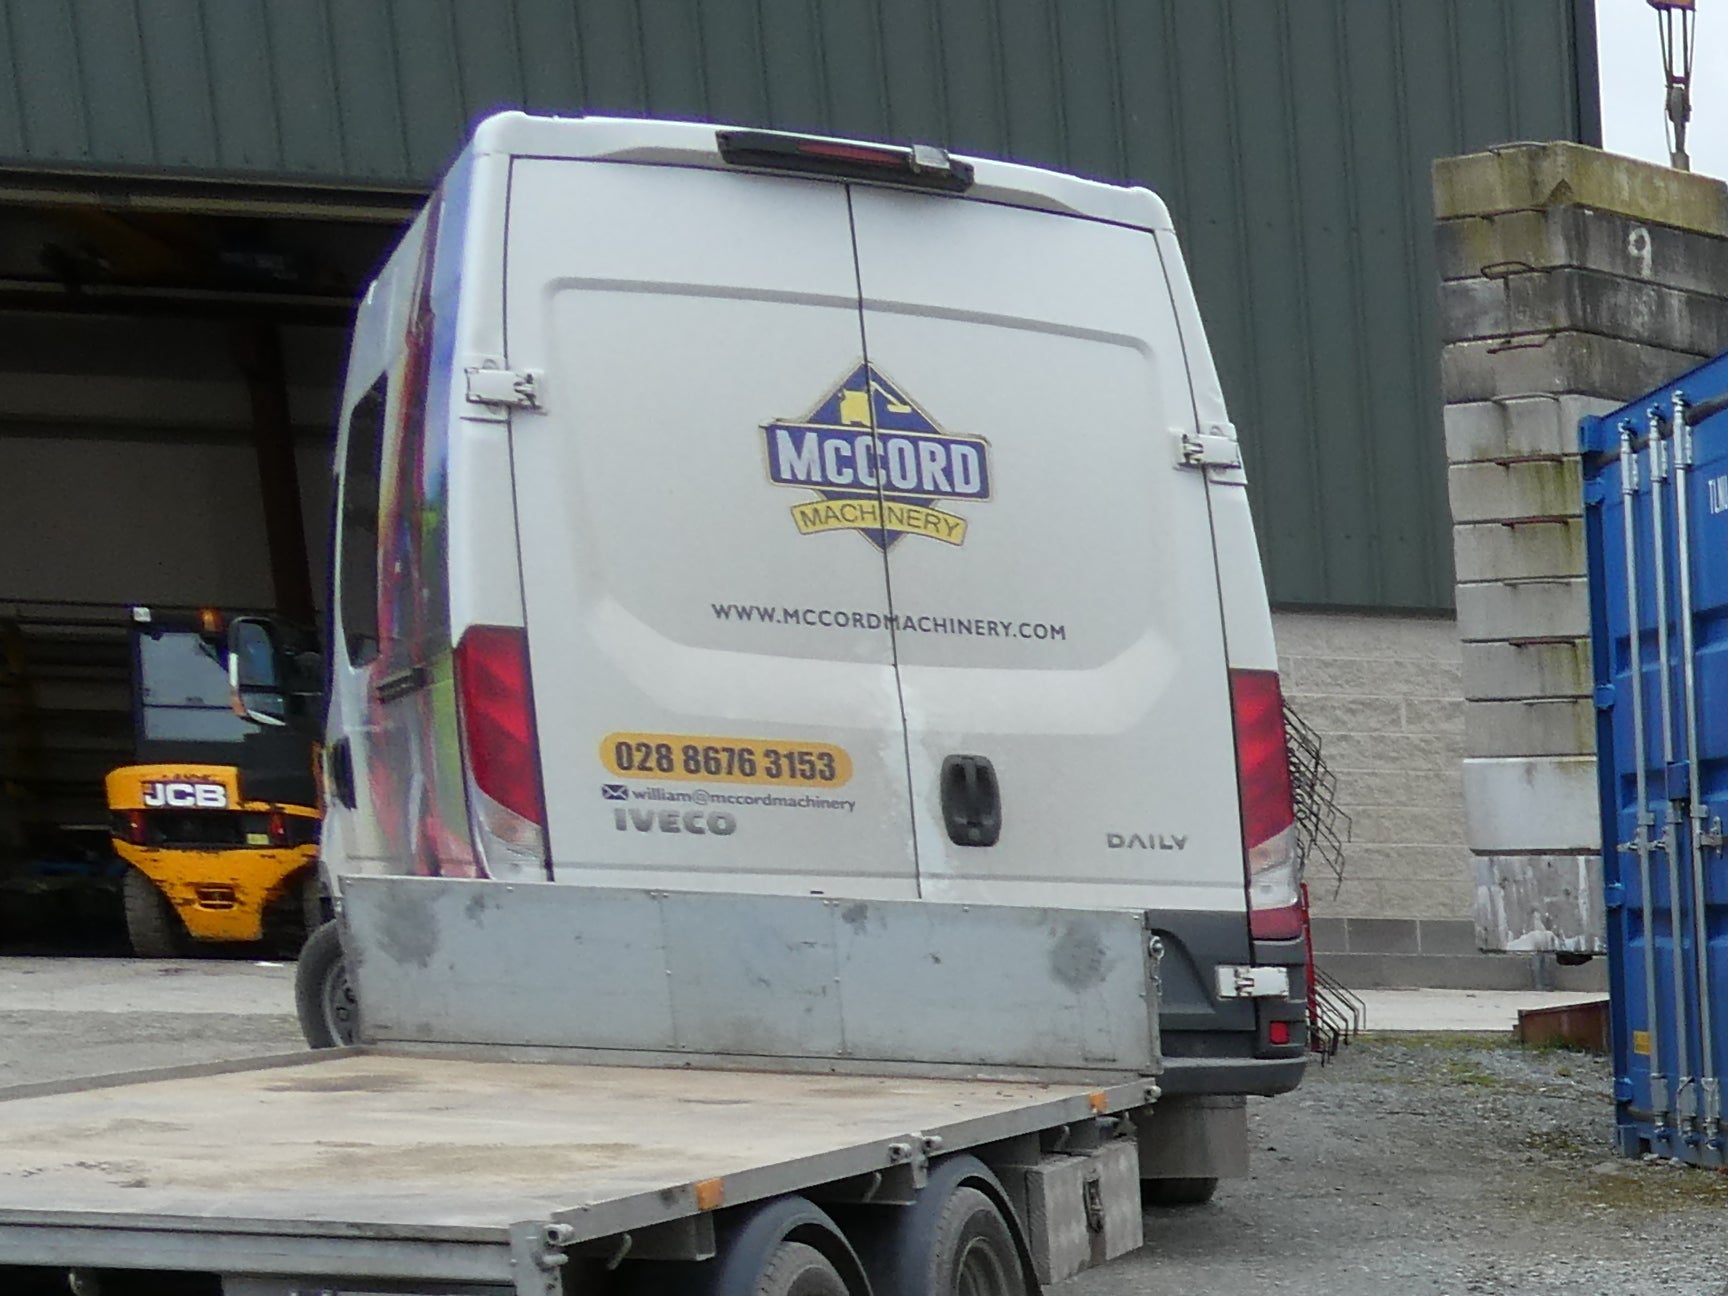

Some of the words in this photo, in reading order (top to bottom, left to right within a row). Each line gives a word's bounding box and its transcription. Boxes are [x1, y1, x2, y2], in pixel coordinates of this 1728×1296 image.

[800, 503, 960, 538] MACHNERY
[711, 603, 1066, 640] WWW.MCCORDMACHINERY.COM
[615, 741, 674, 771] 028
[682, 745, 757, 777] 8676
[764, 749, 837, 781] 3153
[144, 782, 227, 808] JCB
[613, 807, 737, 836] IVECO
[1106, 833, 1188, 851] DAILY
